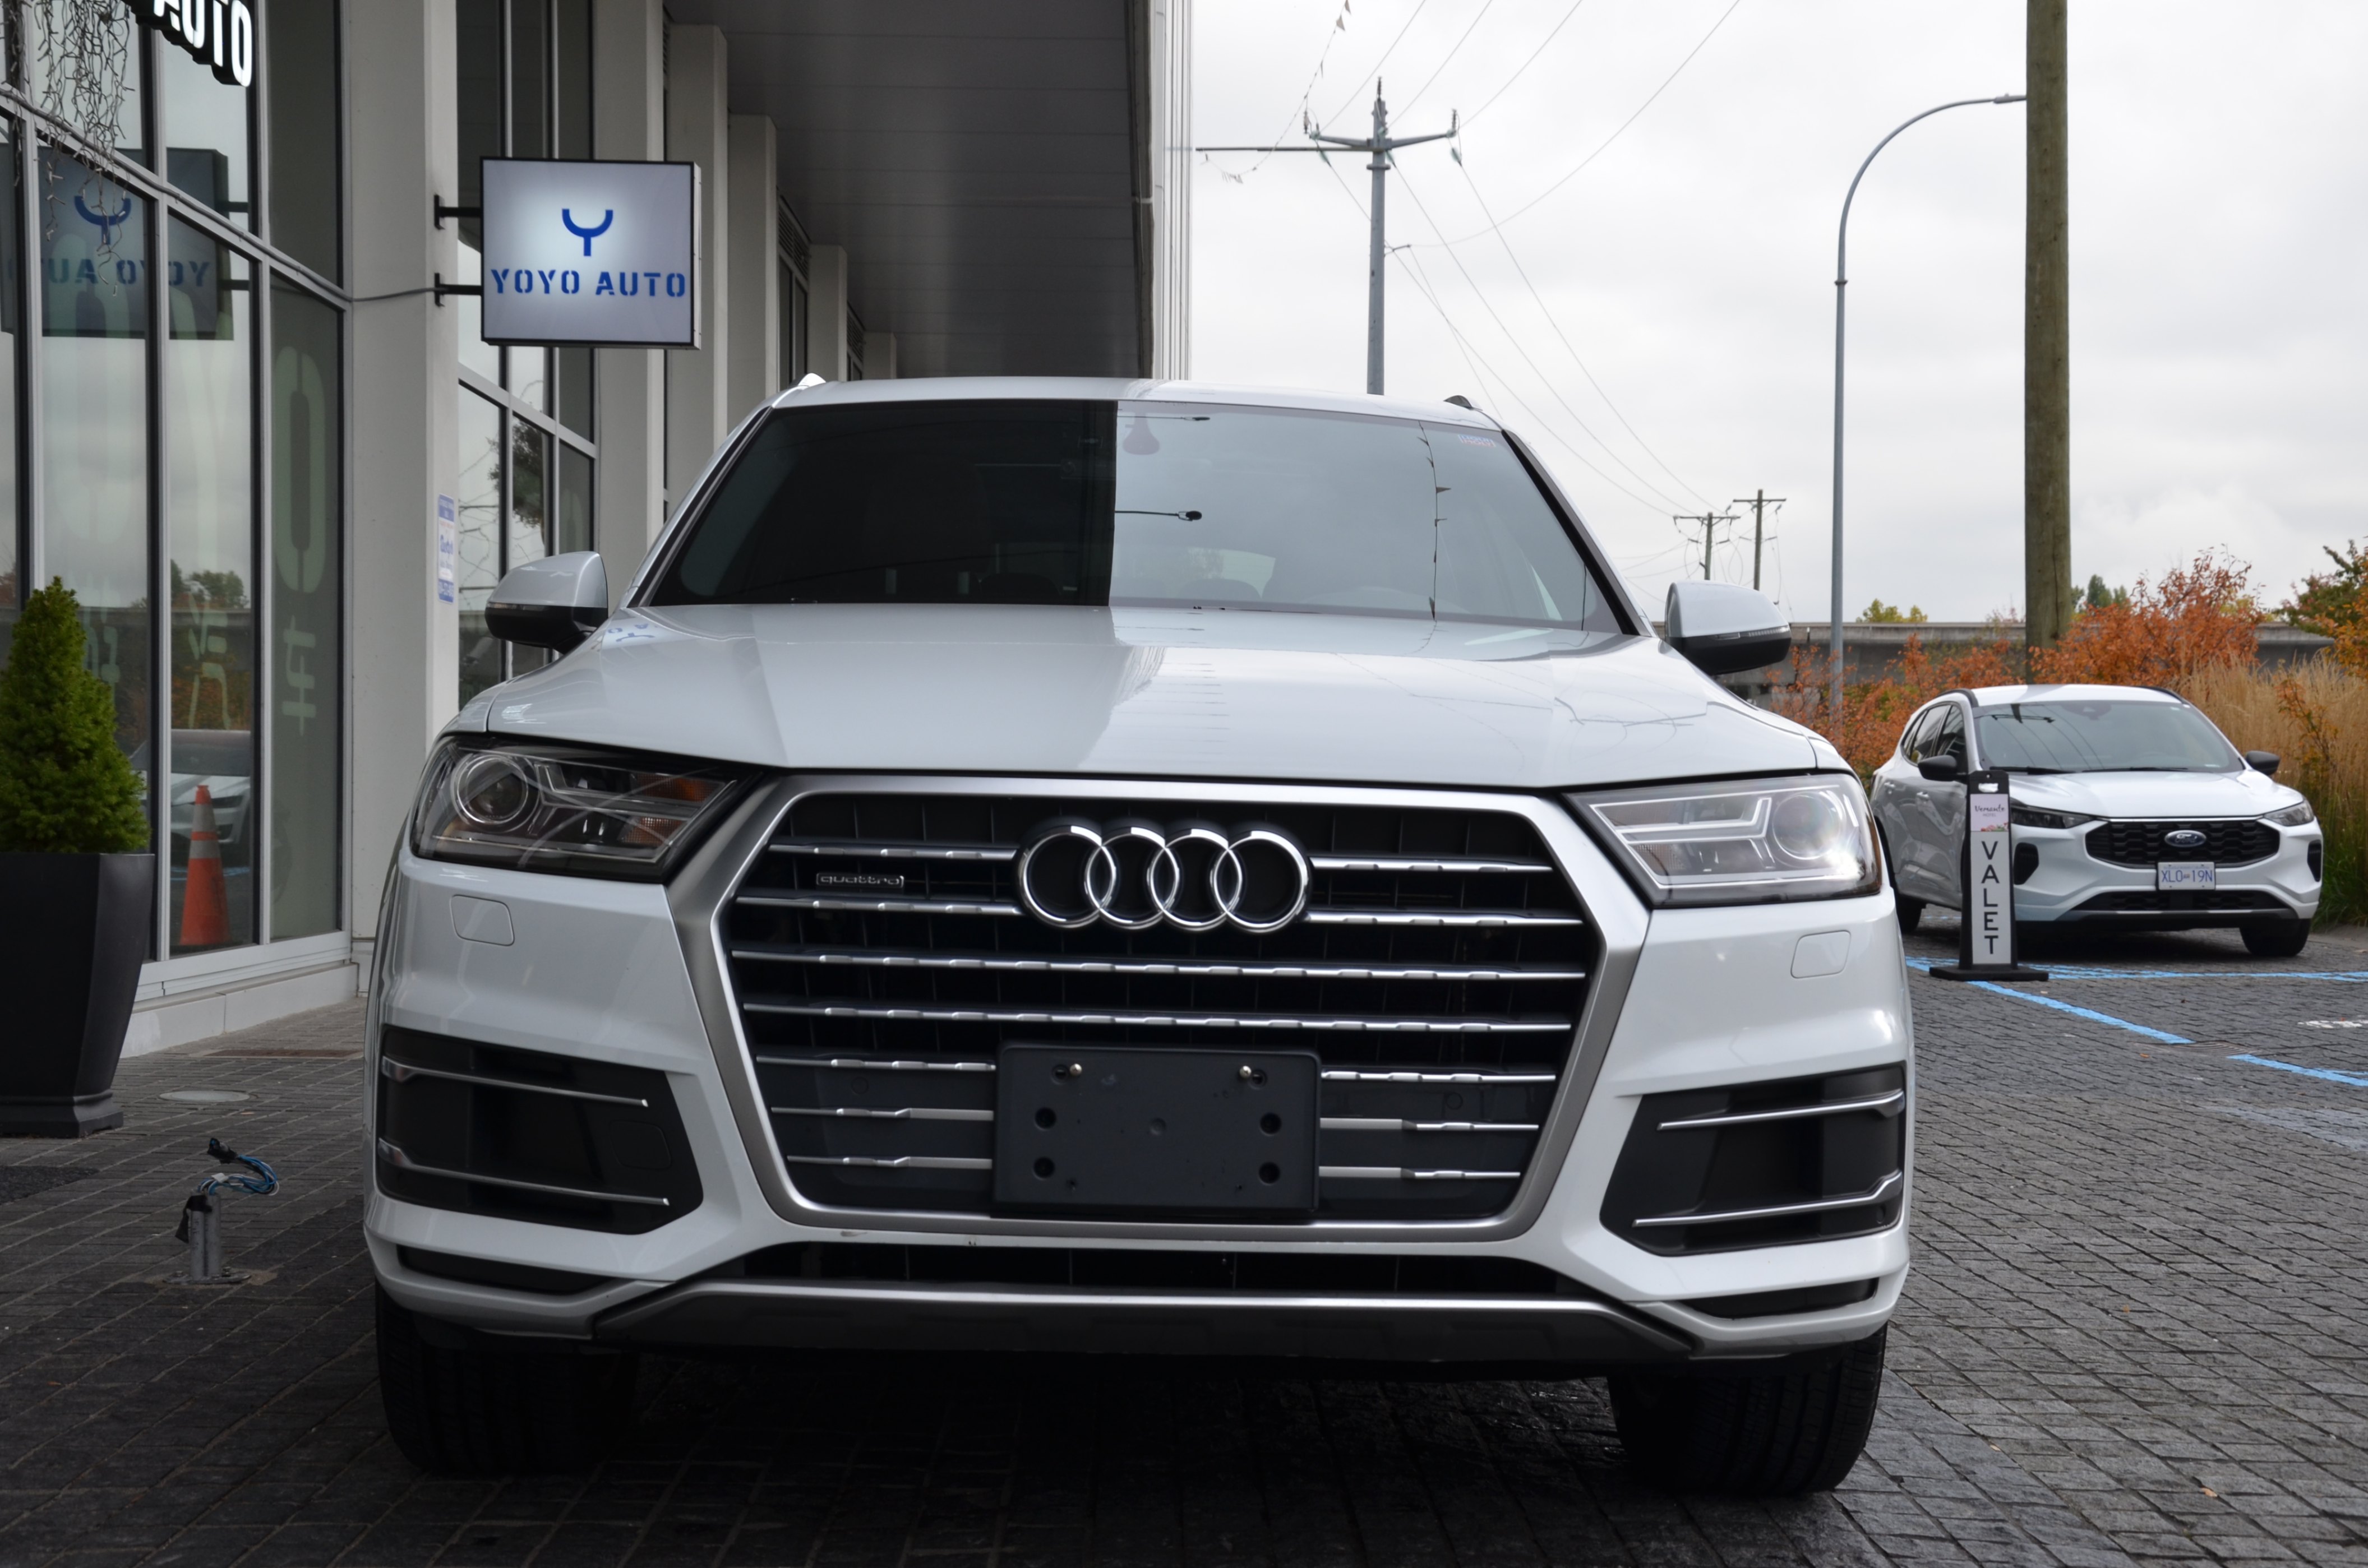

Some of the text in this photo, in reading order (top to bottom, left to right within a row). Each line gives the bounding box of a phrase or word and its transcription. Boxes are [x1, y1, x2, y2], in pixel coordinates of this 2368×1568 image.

[491, 269, 686, 297] YOYO AUTO
[820, 876, 899, 885] quattro
[1981, 841, 2000, 955] VALET
